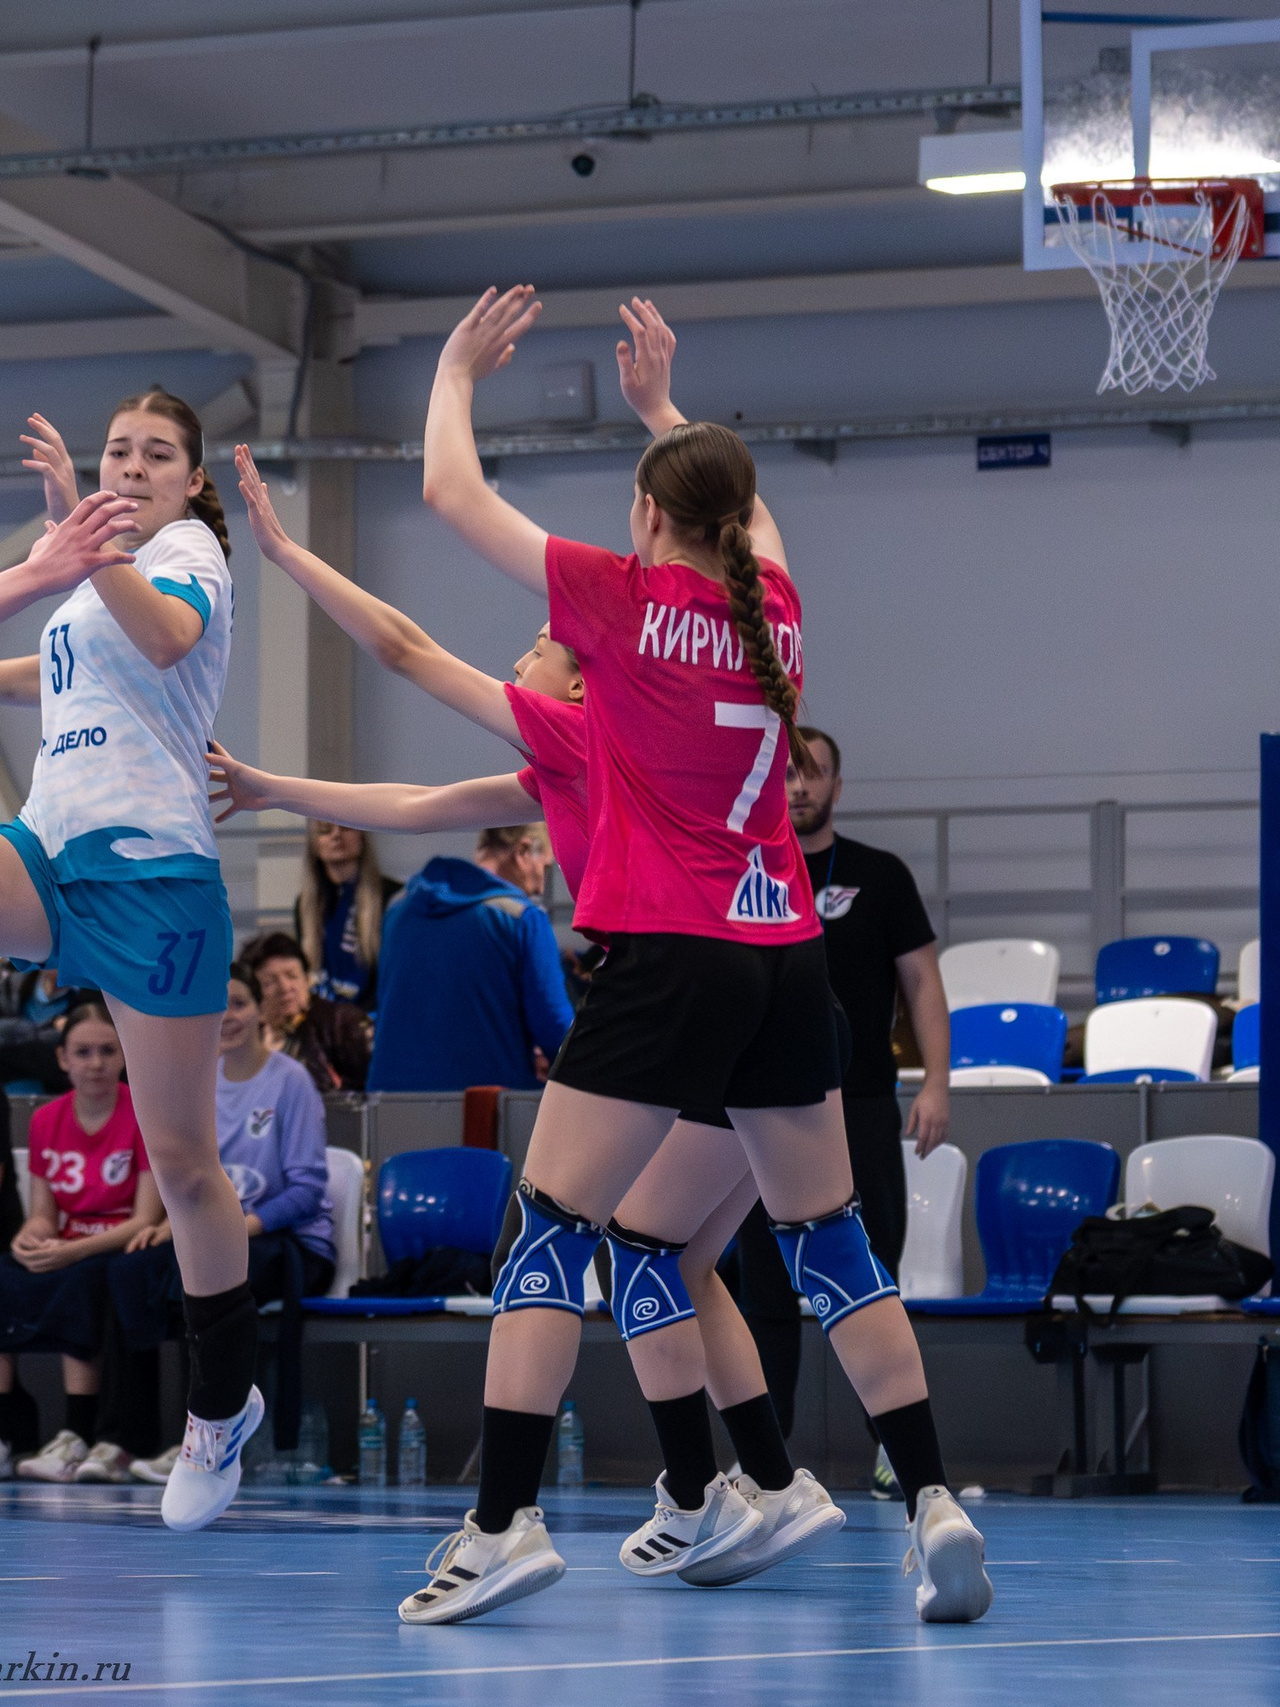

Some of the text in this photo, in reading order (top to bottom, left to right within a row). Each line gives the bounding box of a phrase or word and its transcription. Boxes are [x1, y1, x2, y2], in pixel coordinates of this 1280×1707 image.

[49, 623, 75, 695] 37
[51, 726, 107, 757] ДЕЛО
[715, 701, 781, 834] 7
[148, 929, 206, 996] 37
[41, 1149, 85, 1194] 23
